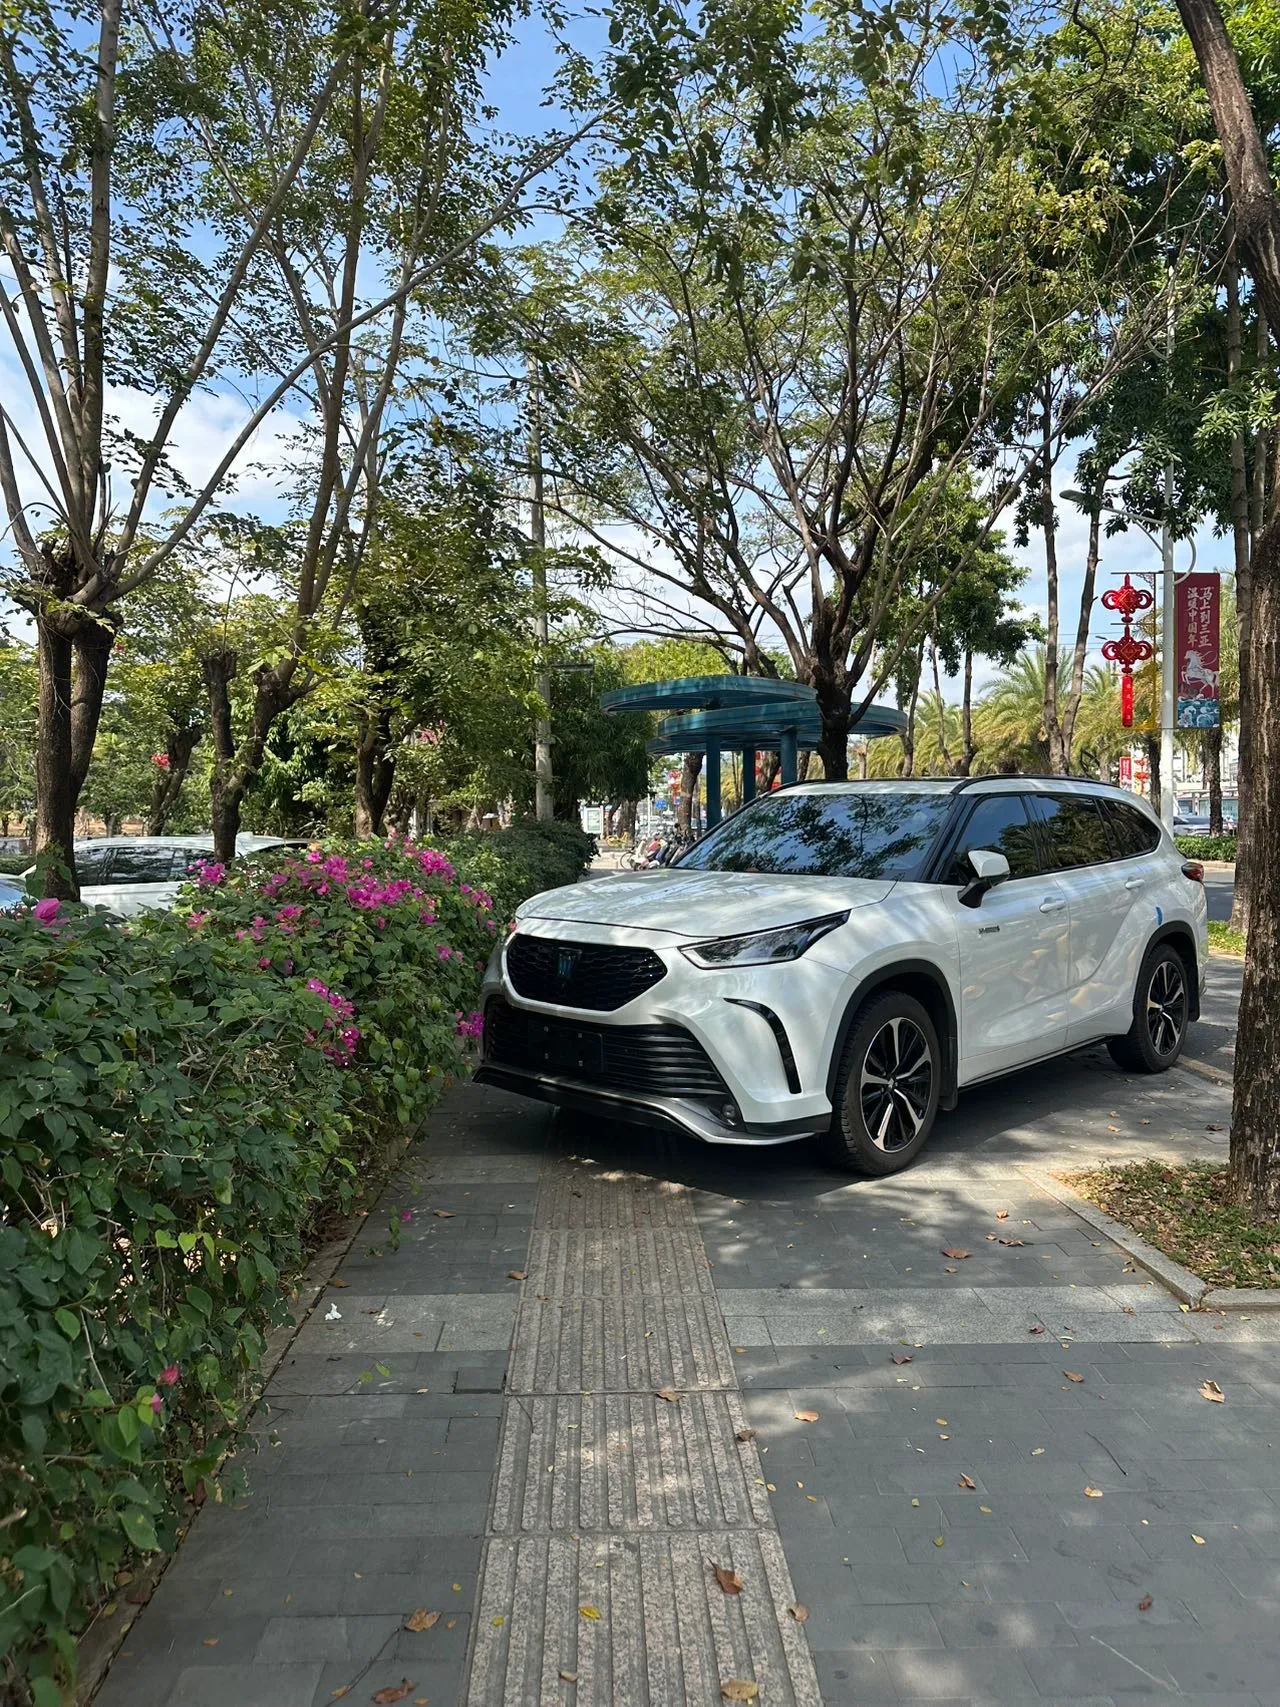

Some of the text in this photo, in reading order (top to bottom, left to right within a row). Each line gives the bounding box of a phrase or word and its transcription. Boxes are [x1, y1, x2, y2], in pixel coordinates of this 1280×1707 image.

[1199, 586, 1214, 648] 马上到三亚
